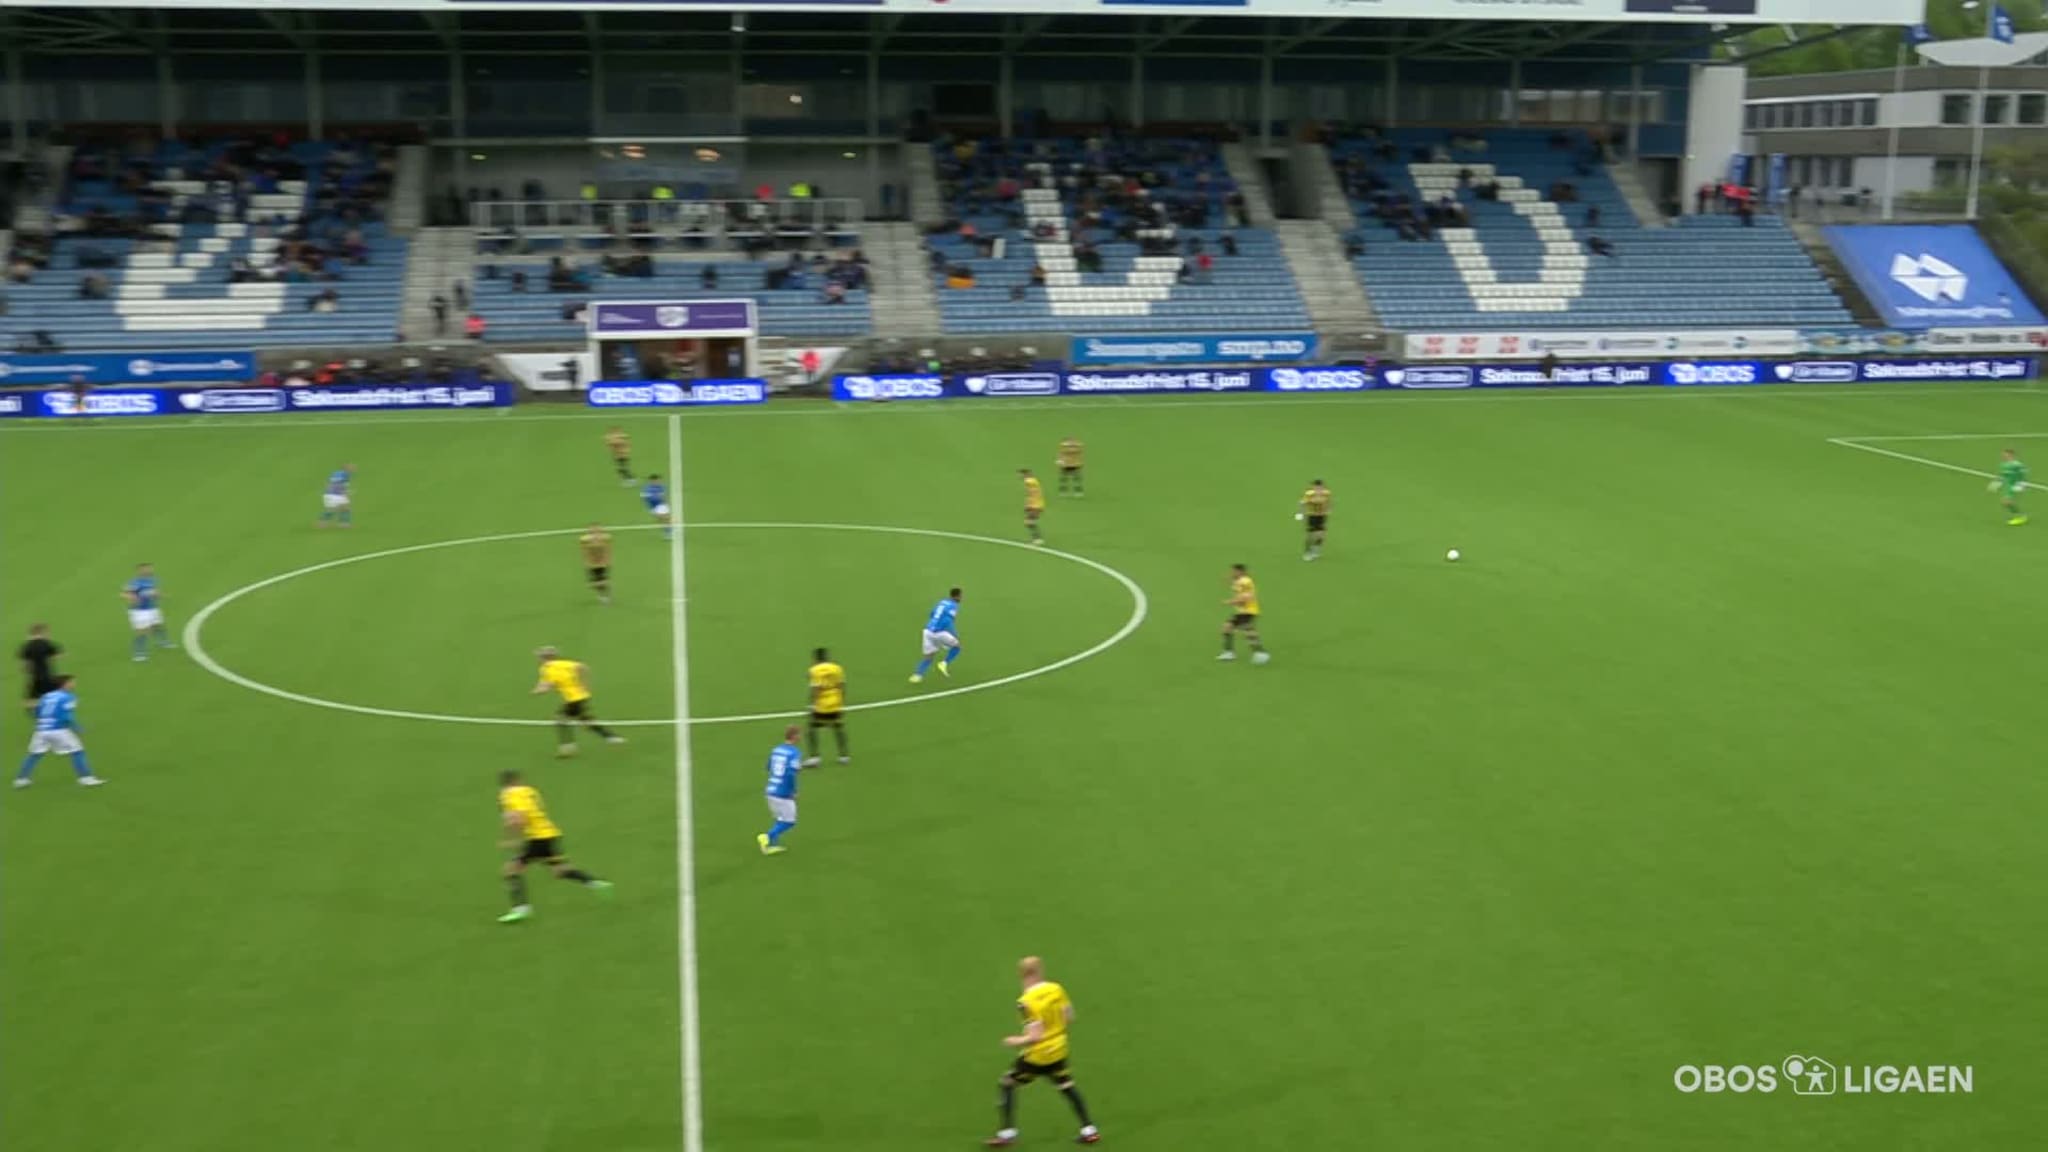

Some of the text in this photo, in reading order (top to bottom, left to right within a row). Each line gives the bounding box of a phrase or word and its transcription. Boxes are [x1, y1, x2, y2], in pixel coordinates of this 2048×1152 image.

[1303, 370, 1364, 388] OBOS
[1699, 365, 1755, 383] OBOS
[875, 378, 943, 397] OBOS
